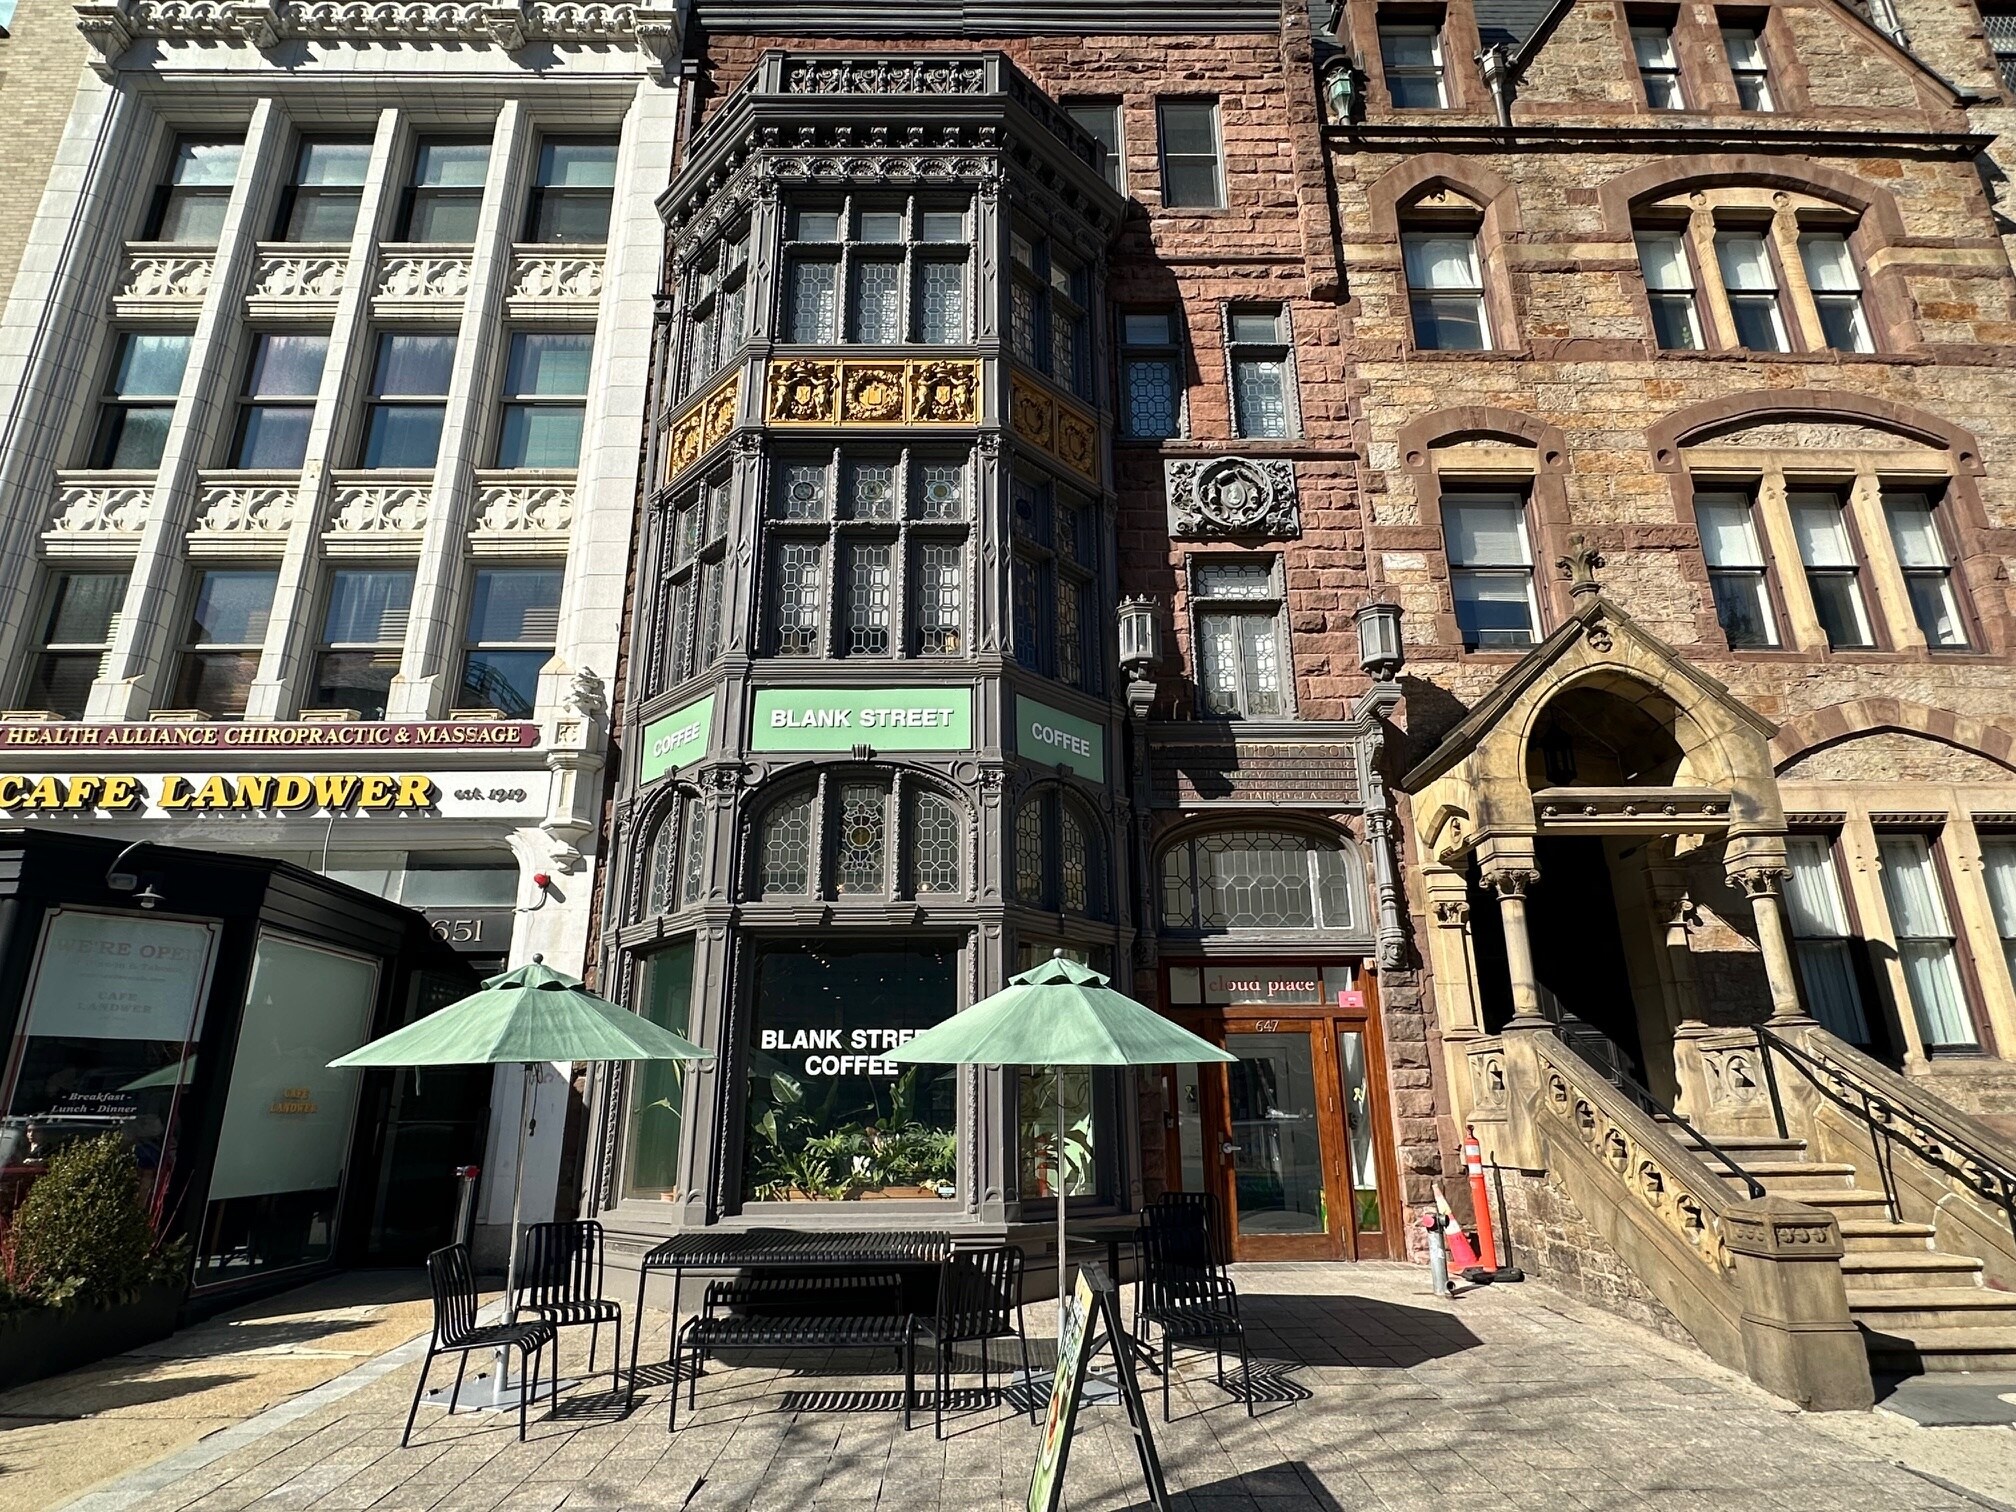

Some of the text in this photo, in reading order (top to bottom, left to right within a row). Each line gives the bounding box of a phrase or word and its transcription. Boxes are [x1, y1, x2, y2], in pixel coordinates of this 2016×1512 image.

[771, 707, 954, 728] BLANK STREET
[5, 727, 100, 745] HEALTH
[104, 727, 218, 745] ALLIANCE
[224, 726, 391, 745] CHIROPRACTIC
[394, 727, 410, 744] &
[416, 726, 521, 745] MASSAGE
[652, 720, 701, 758] COFFEE
[1031, 722, 1091, 758] COFFEE
[0, 775, 437, 810] CAFE LANDWER
[487, 788, 527, 803] 1919
[431, 918, 483, 943] 651
[1209, 975, 1315, 997] cloud place
[1255, 1019, 1280, 1033] 647
[761, 1029, 930, 1050] BLANK STRE
[804, 1055, 900, 1075] COFFEE
[68, 1092, 126, 1102] Breakfast
[51, 1104, 138, 1113] Lunch Dinner
